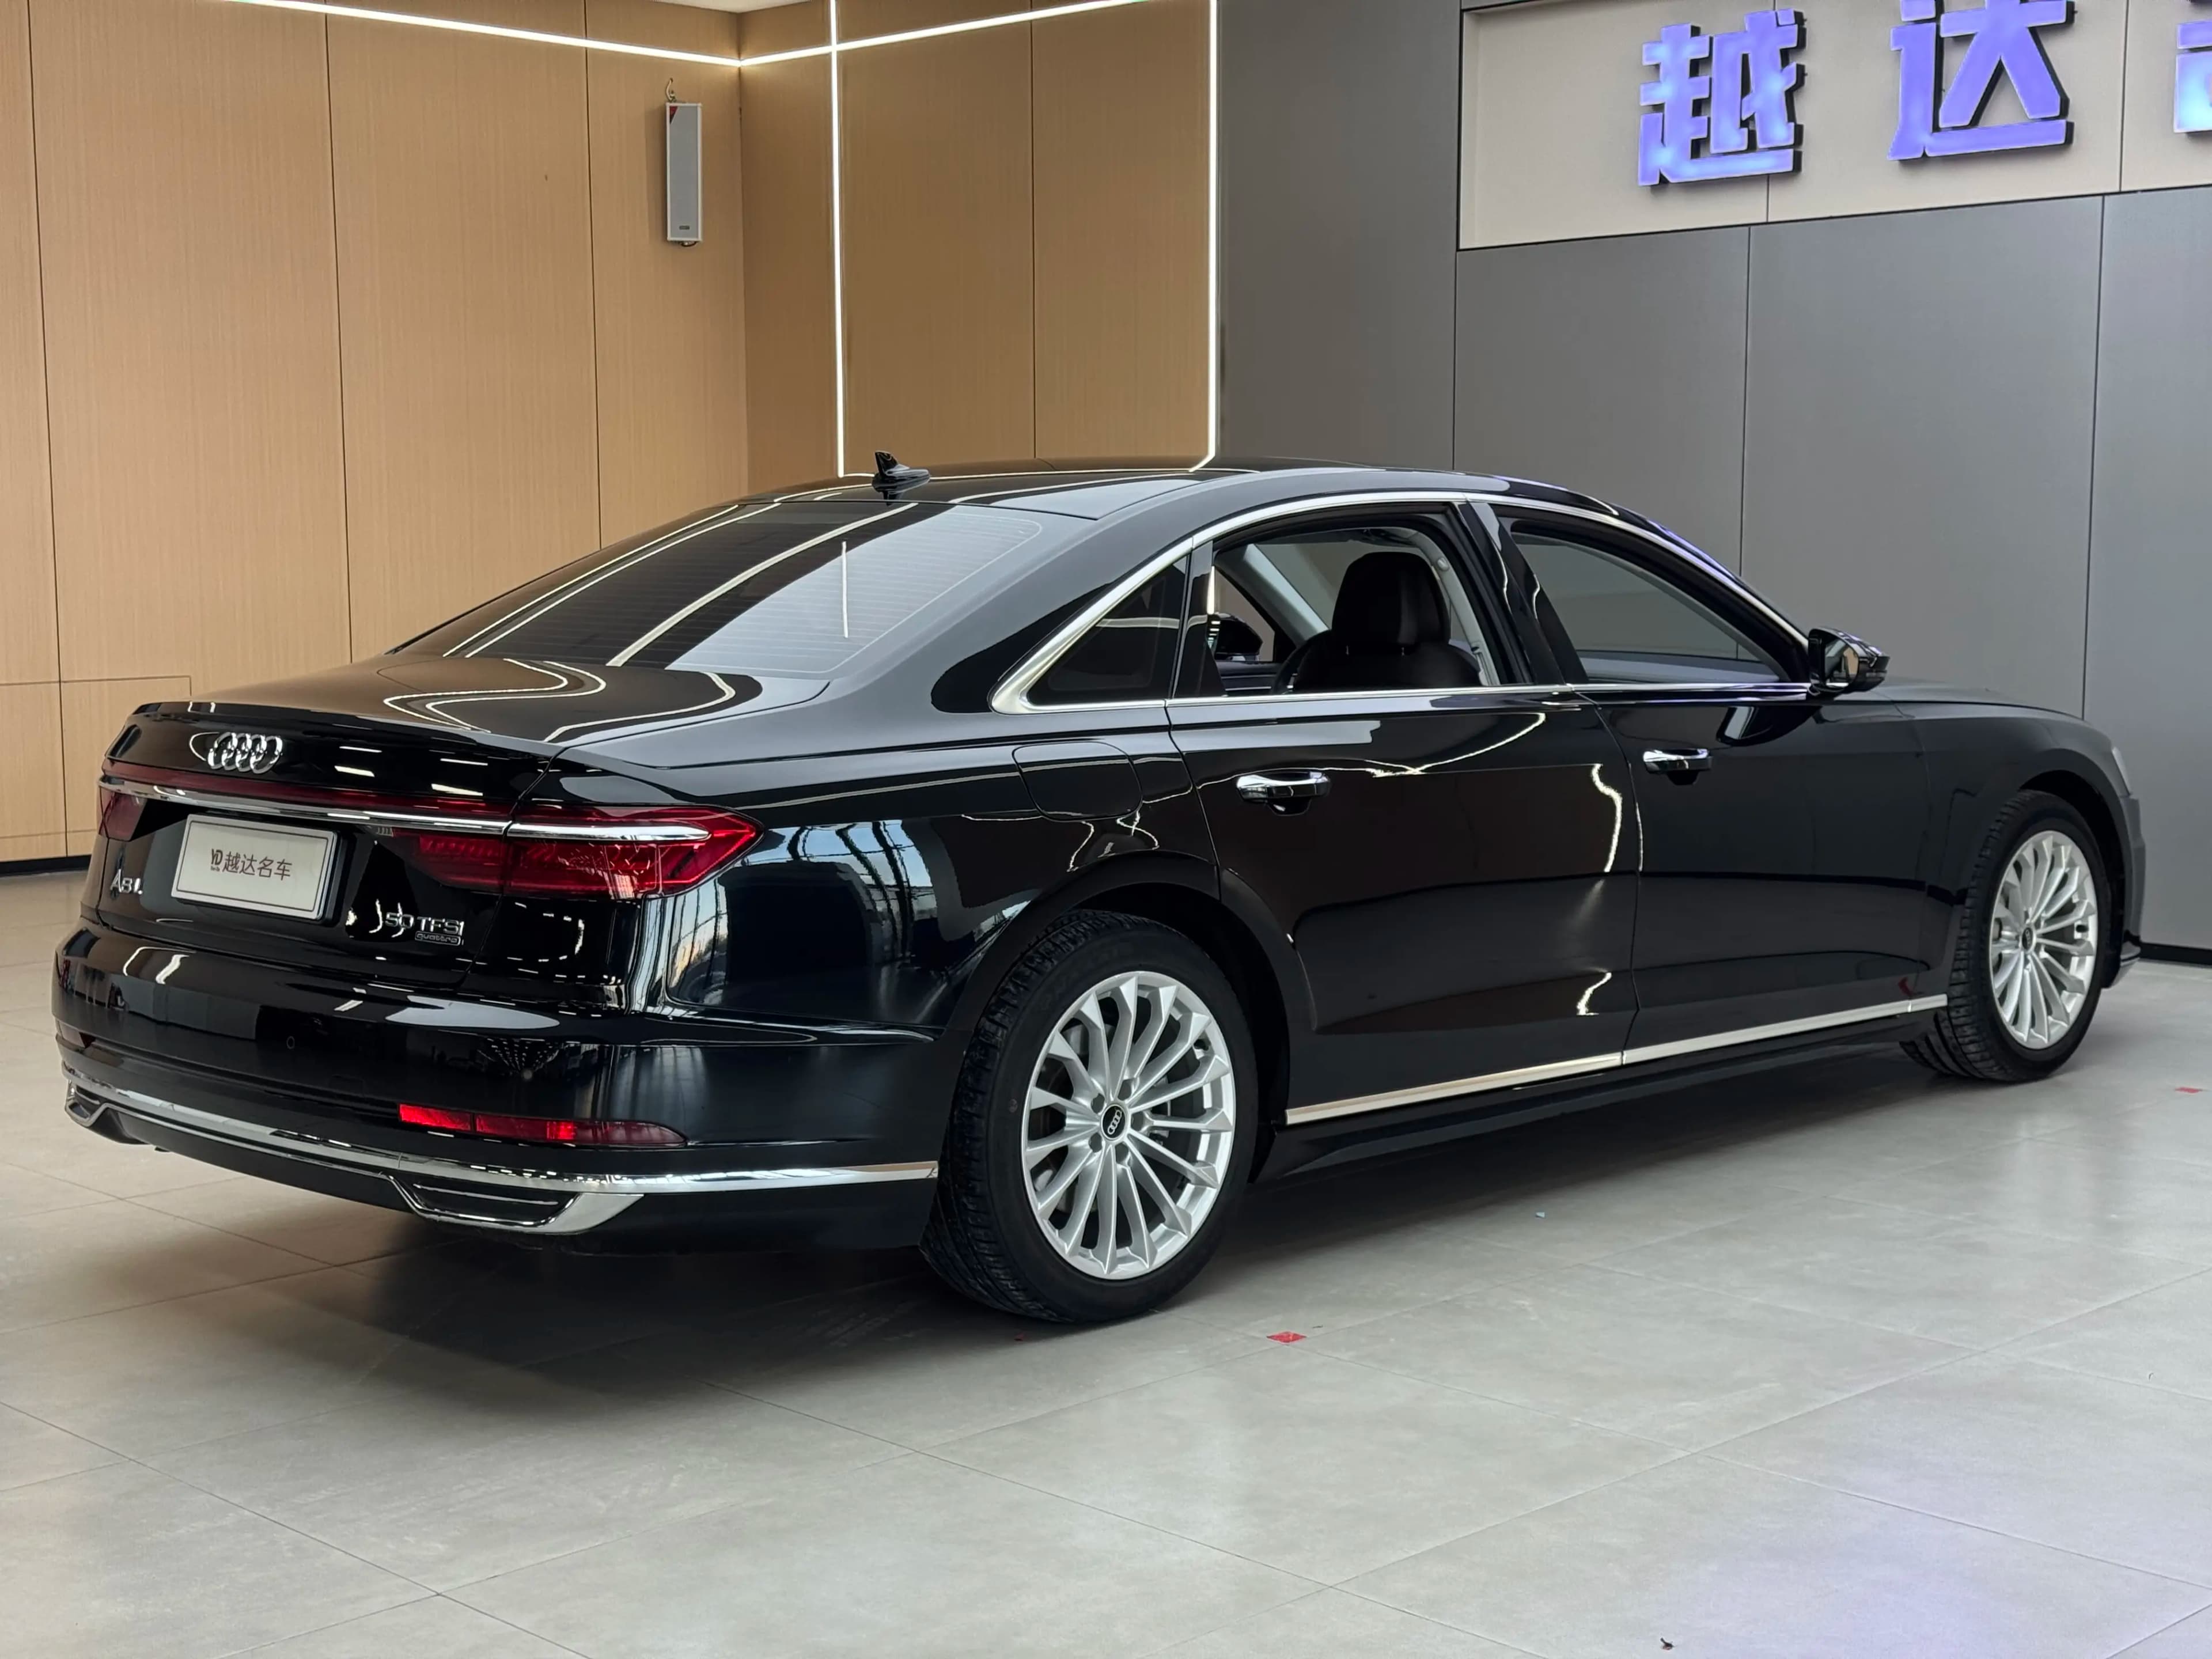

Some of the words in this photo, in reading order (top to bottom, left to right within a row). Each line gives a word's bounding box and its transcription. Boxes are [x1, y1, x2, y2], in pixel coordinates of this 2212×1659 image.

[1638, 0, 2212, 185] 越达
[222, 851, 292, 880] 越达名车
[385, 912, 414, 929] 50
[417, 916, 464, 935] TFSI
[416, 933, 459, 944] quattro
